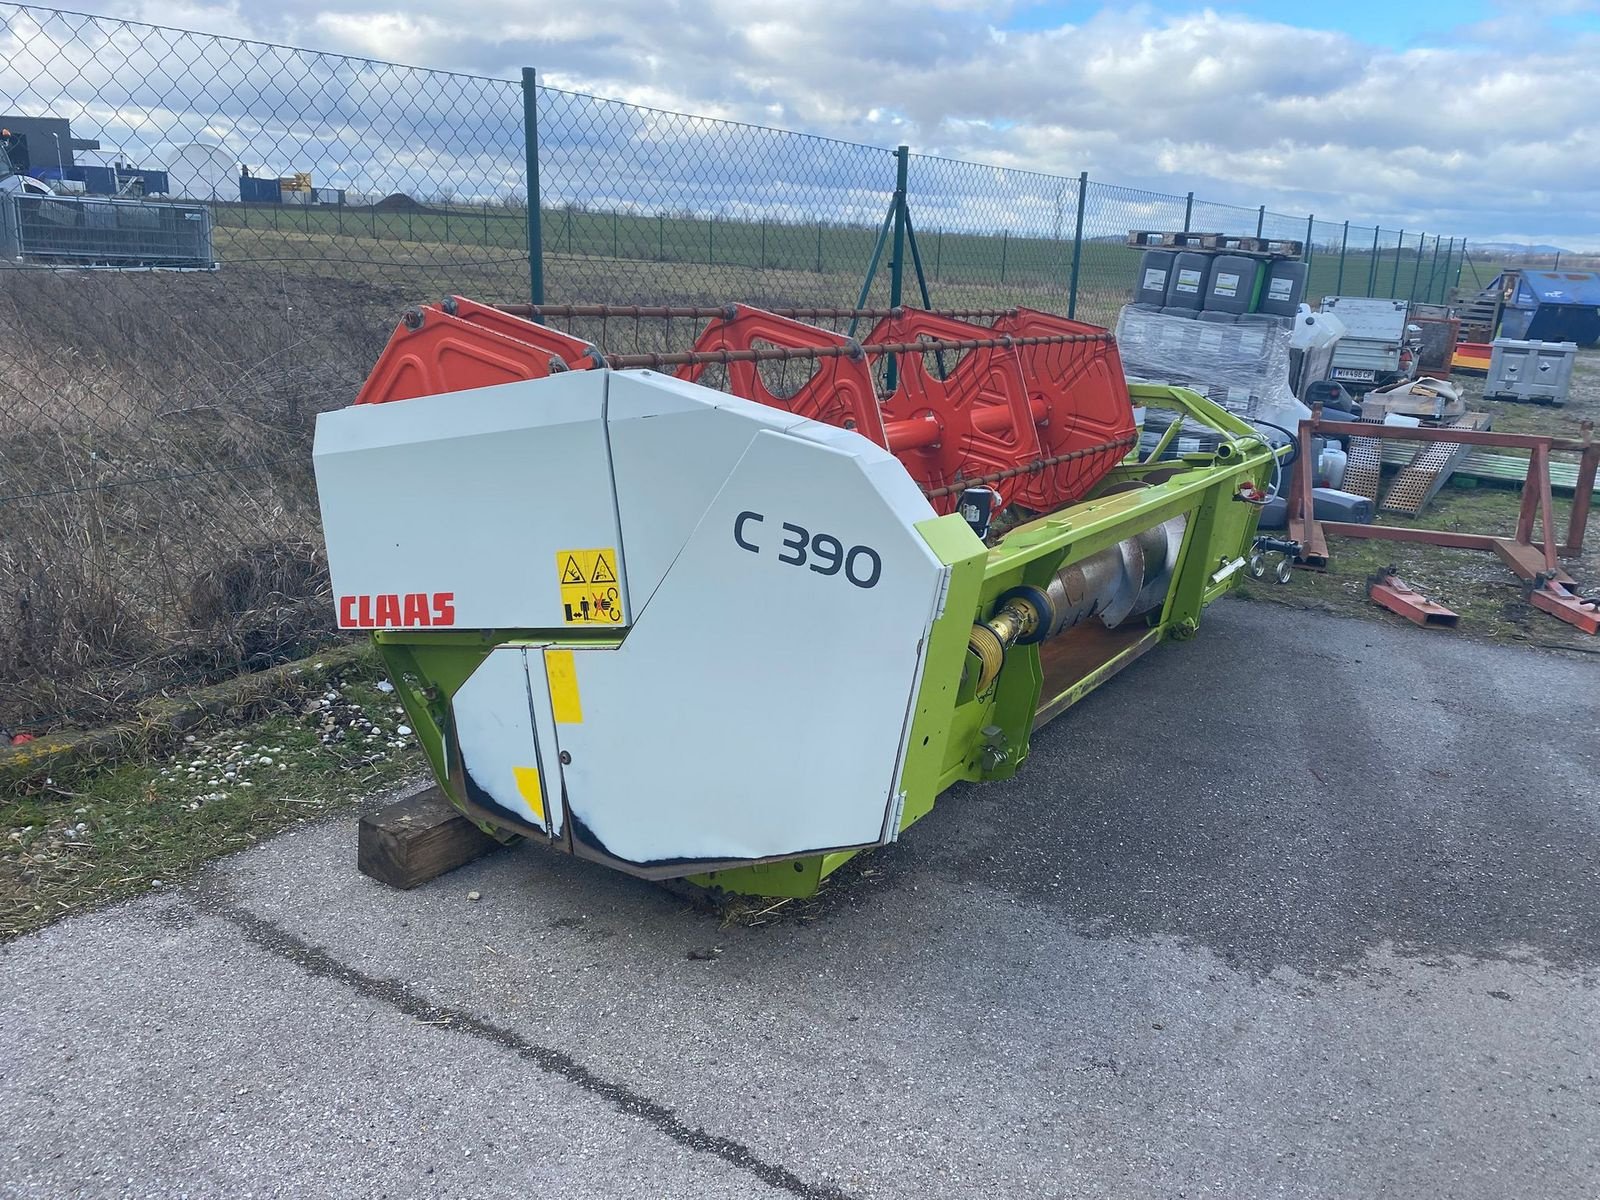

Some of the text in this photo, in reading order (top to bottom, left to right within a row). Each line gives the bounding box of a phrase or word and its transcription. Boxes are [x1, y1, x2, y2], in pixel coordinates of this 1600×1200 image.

[734, 511, 882, 589] C 390
[340, 592, 455, 627] CLAAS
